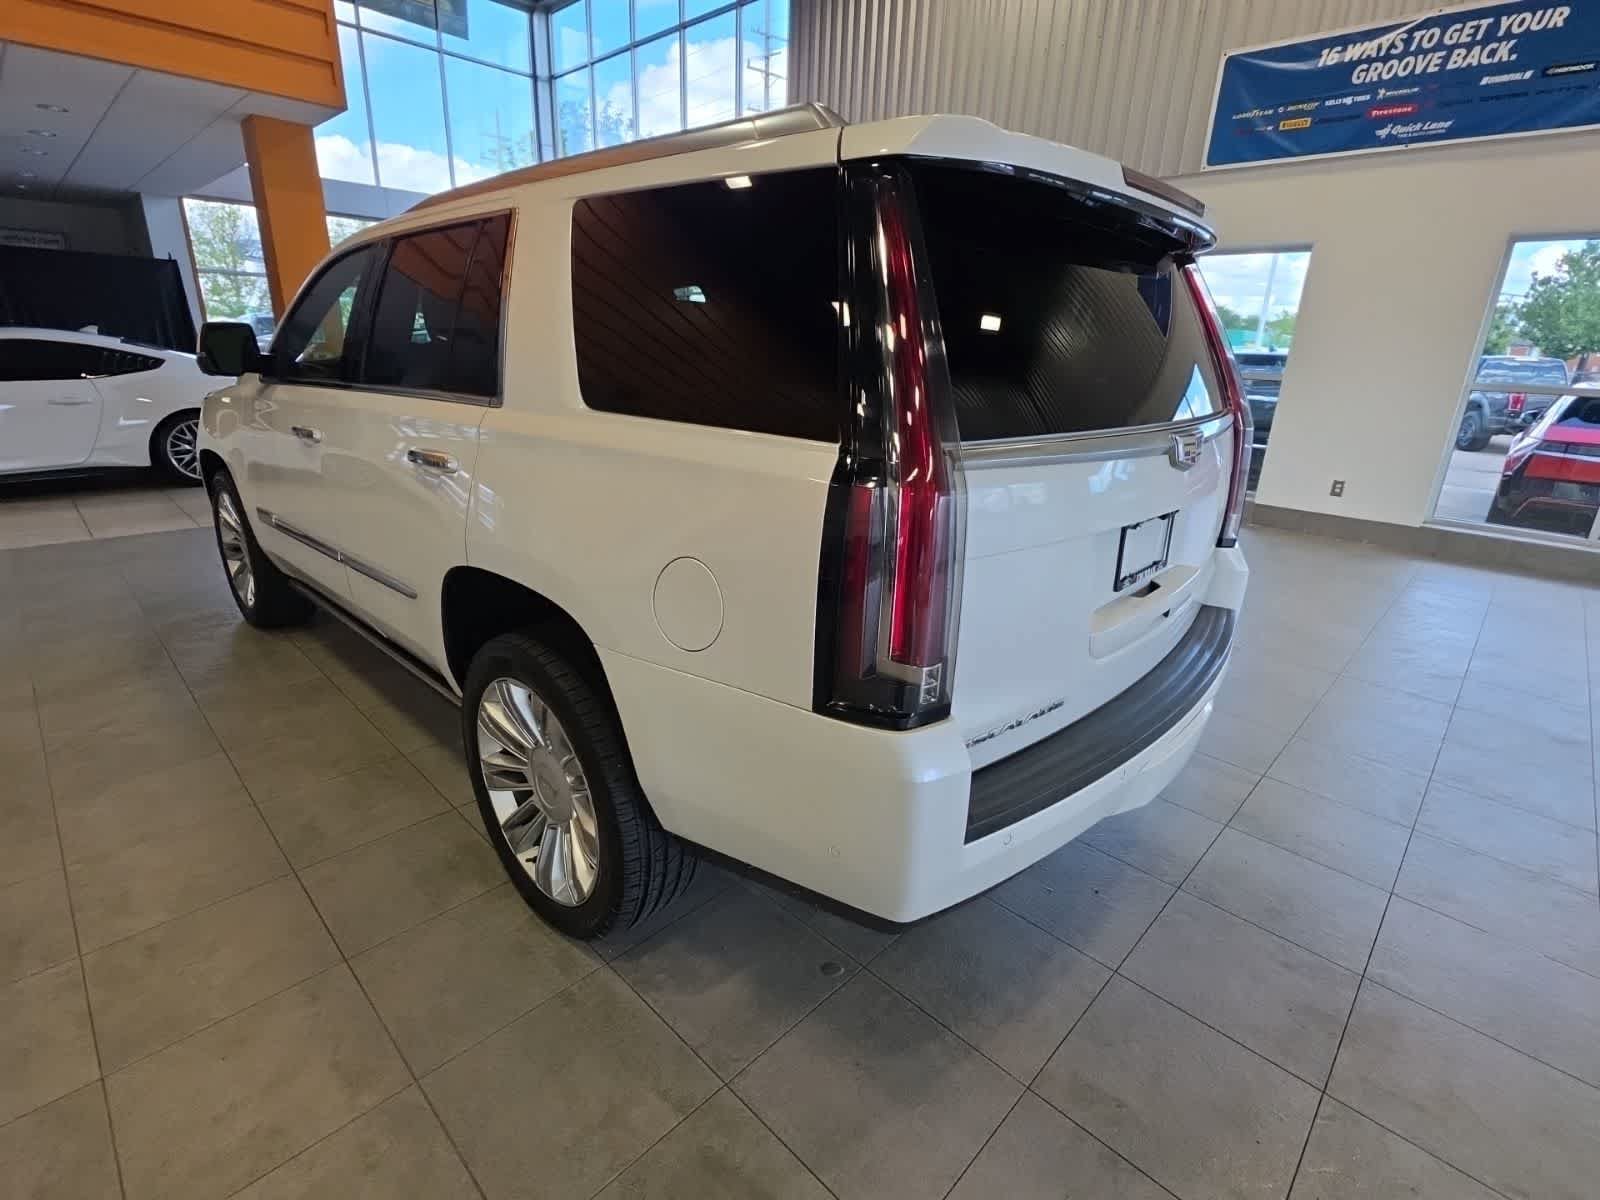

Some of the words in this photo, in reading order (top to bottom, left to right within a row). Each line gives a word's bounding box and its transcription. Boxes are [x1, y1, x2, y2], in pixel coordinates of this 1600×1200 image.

[1317, 47, 1343, 68] 16
[1343, 33, 1407, 63] WAYS
[1410, 27, 1441, 52] TO
[1443, 18, 1494, 46] GET
[1496, 6, 1571, 37] YOUR
[1351, 49, 1445, 85] GROOVE
[1447, 40, 1519, 70] BACK.
[1391, 121, 1424, 136] Quick
[1422, 119, 1455, 131] Lane
